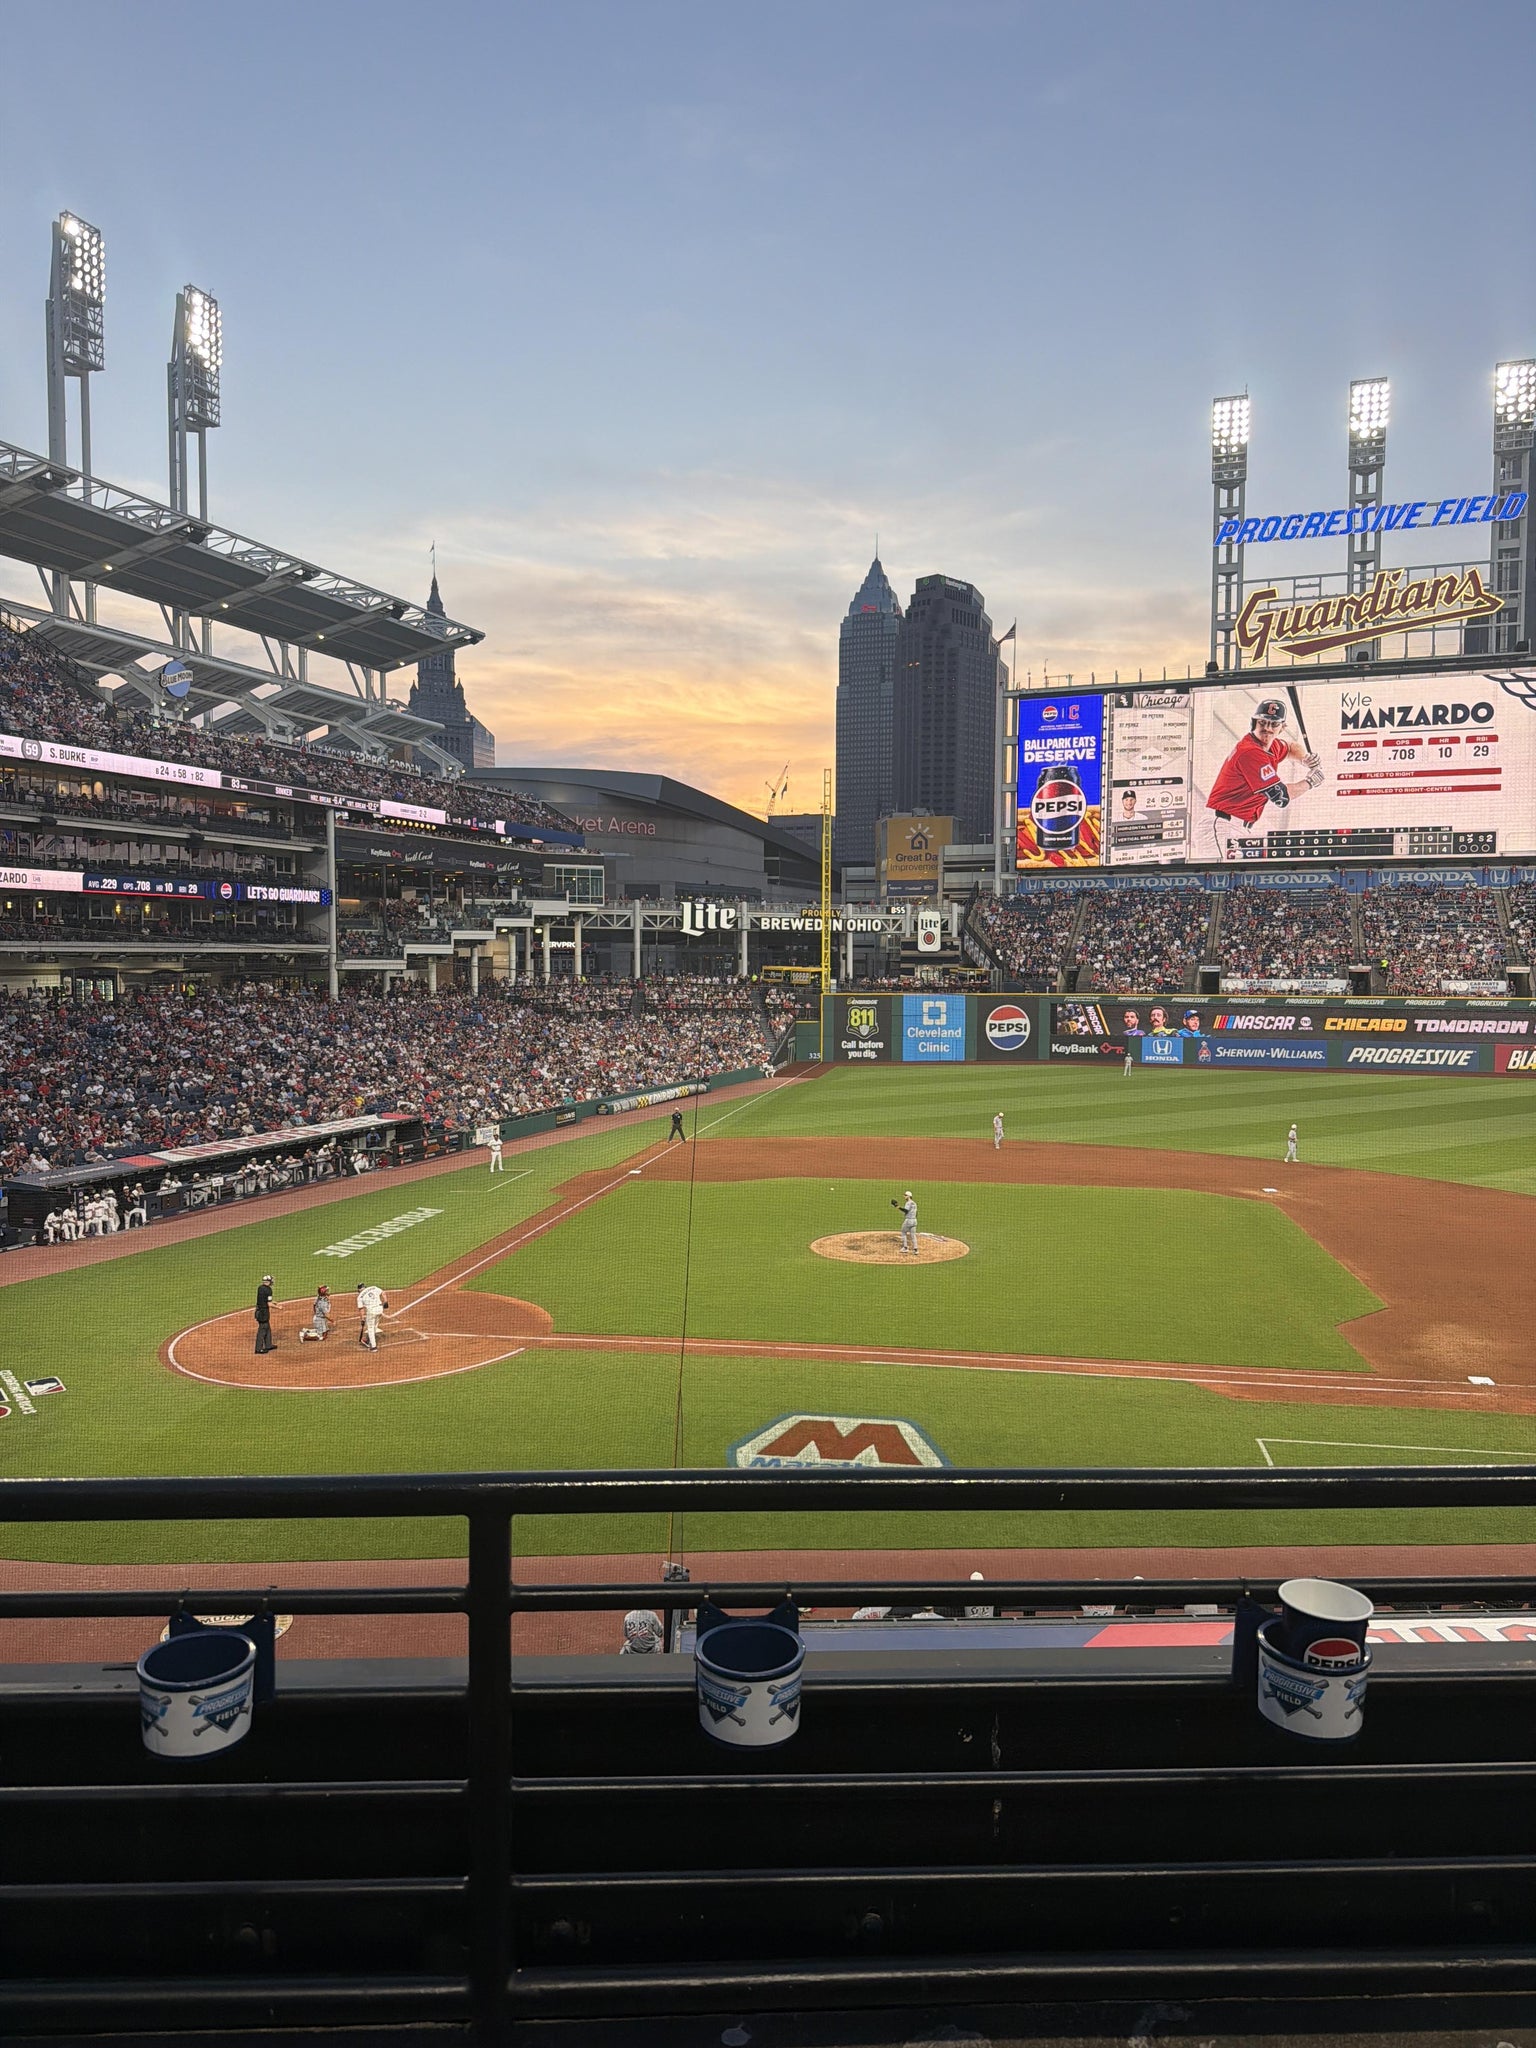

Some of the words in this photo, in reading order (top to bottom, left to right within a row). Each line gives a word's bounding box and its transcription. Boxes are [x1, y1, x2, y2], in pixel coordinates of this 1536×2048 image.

[1214, 501, 1428, 546] PROGRESSIVE
[1431, 492, 1529, 526] FIELD
[1235, 568, 1504, 666] Guardians
[1141, 694, 1184, 708] Chicago
[1341, 692, 1372, 707] Kyle
[1341, 701, 1495, 730] MANZARDO
[26, 743, 38, 756] 59
[1024, 737, 1071, 751] BALLPARK
[1072, 736, 1096, 748] EATS
[49, 747, 58, 759] S.
[60, 749, 86, 763] BURKE
[1024, 748, 1096, 763] DESERVE
[1343, 750, 1369, 762] .229
[1388, 748, 1415, 760] .708
[1438, 746, 1452, 758] 10
[1473, 745, 1489, 757] 29
[160, 766, 169, 776] 24
[178, 769, 187, 779] 58
[195, 771, 204, 782] 82
[231, 778, 240, 788] 83
[1035, 801, 1082, 813] PEPSI
[607, 817, 656, 835] Arena
[1486, 834, 1493, 842] 2
[371, 848, 391, 858] KeyBank
[895, 853, 922, 862] Great
[1042, 878, 1109, 889] HONDA
[1131, 876, 1202, 887] HONDA
[1259, 874, 1334, 884] HONDA
[1397, 872, 1476, 883] HONDA
[101, 879, 117, 889] .229
[135, 881, 150, 891] .708
[165, 883, 173, 893] 10
[188, 884, 198, 894] 29
[247, 886, 267, 899] LET'S
[268, 888, 278, 900] GO
[280, 888, 319, 902] GUARDIANS!
[680, 901, 736, 937] Lite
[761, 918, 823, 931] BREWED
[847, 919, 881, 932] OHIO
[921, 919, 939, 930] Lite
[850, 1008, 875, 1026] 811
[1086, 1006, 1104, 1035] NASCAR
[1232, 1015, 1296, 1031] NASCAR
[989, 1023, 1028, 1032] PEPSI
[1324, 1018, 1407, 1032] CHICAGO
[1414, 1019, 1529, 1034] TOMORROW
[907, 1027, 962, 1038] Cleveland
[841, 1040, 856, 1049] Call
[858, 1040, 884, 1049] before
[918, 1041, 950, 1053] Clinic
[1051, 1044, 1099, 1054] KeyBank
[848, 1050, 862, 1059] you
[863, 1050, 878, 1059] dig.
[1347, 1048, 1475, 1066] PROGRESSIVE
[1266, 1672, 1317, 1697] PROGRESSIVE
[1276, 1691, 1301, 1705] FIELD
[216, 1707, 240, 1721] FIELD
